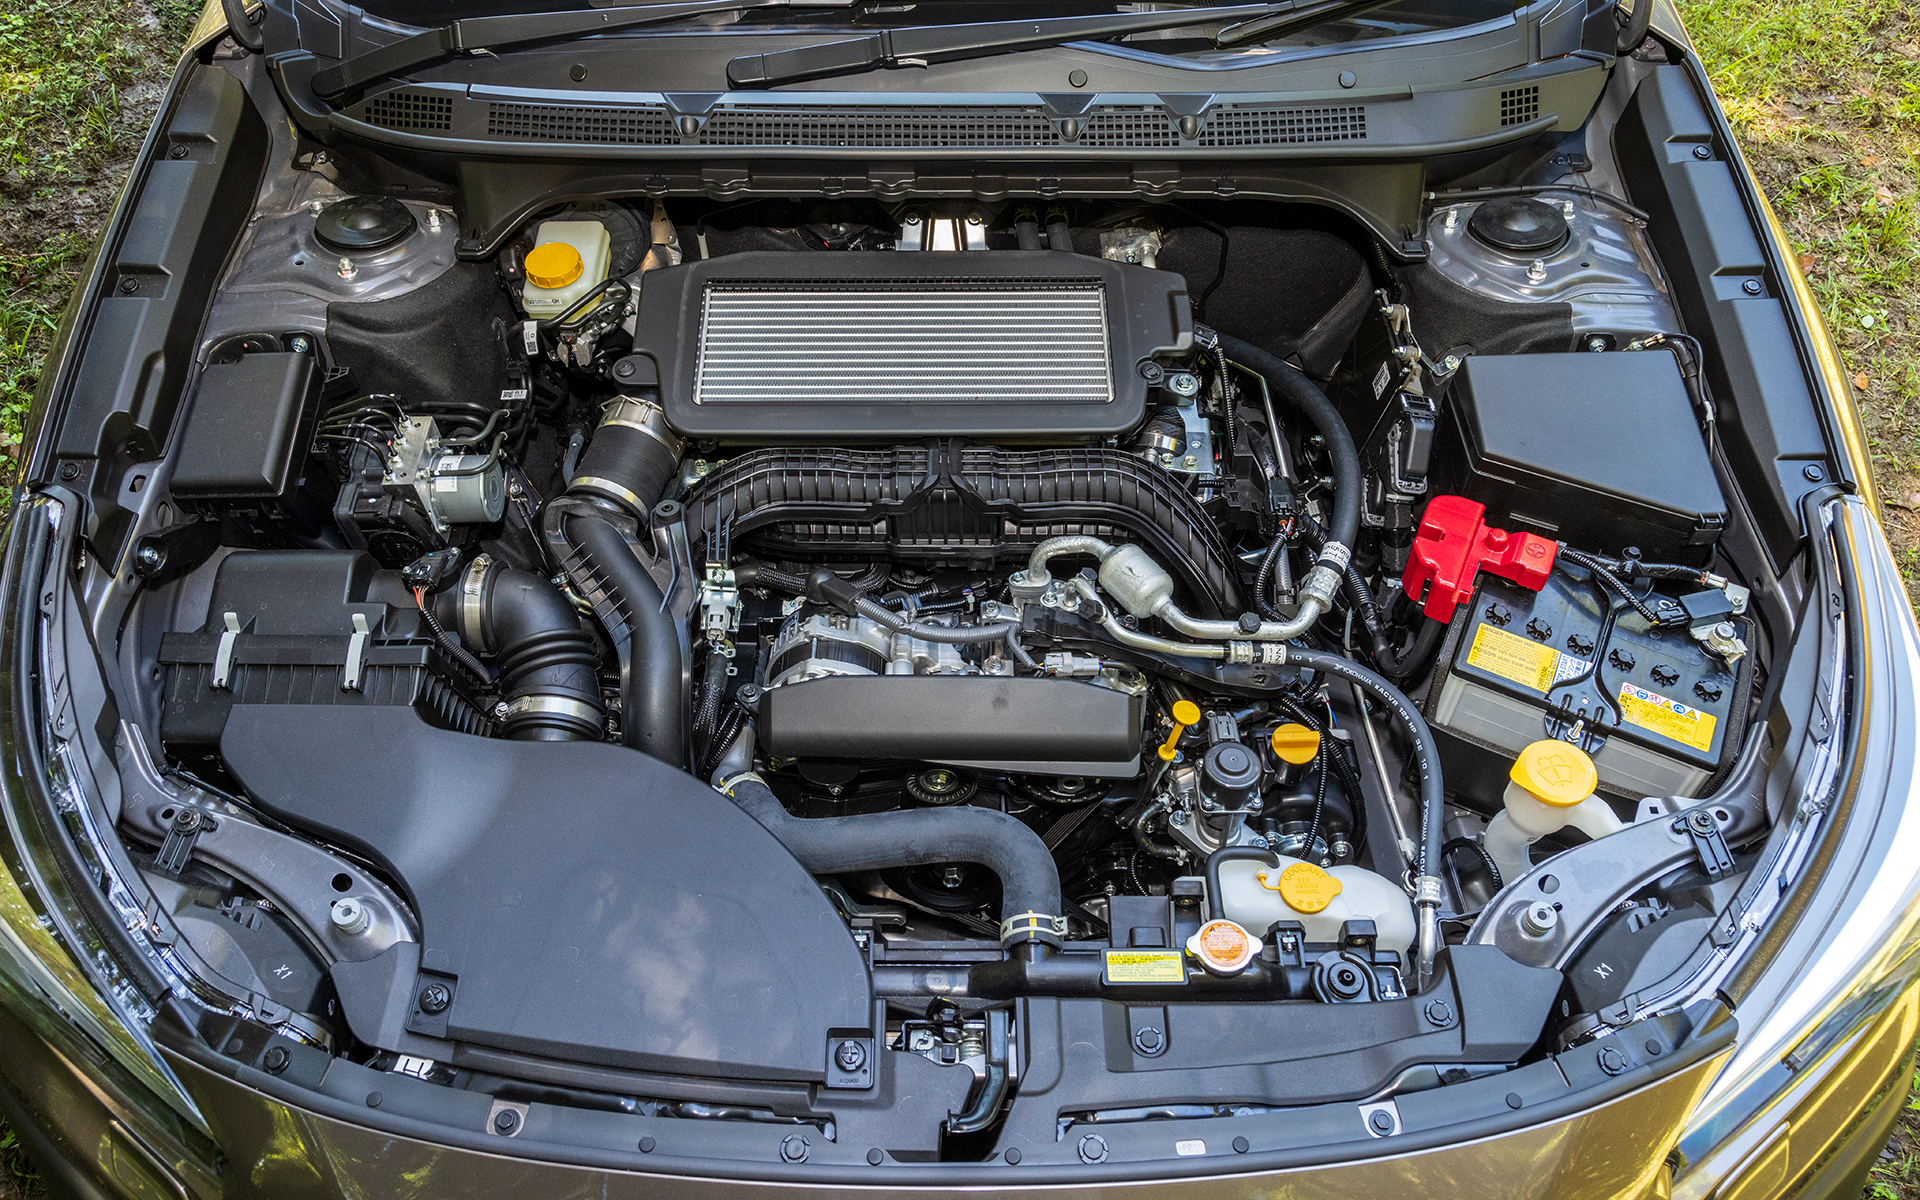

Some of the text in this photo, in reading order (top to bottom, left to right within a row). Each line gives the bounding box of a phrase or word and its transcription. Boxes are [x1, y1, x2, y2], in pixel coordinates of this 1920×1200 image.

[1481, 625, 1504, 636] DANGER
[1474, 646, 1496, 657] POISON
[1342, 666, 1372, 685] YOKOHAMA
[1408, 722, 1417, 733] HP
[1283, 865, 1327, 881] COOLANT
[273, 964, 293, 980] X1
[1593, 962, 1614, 979] X1
